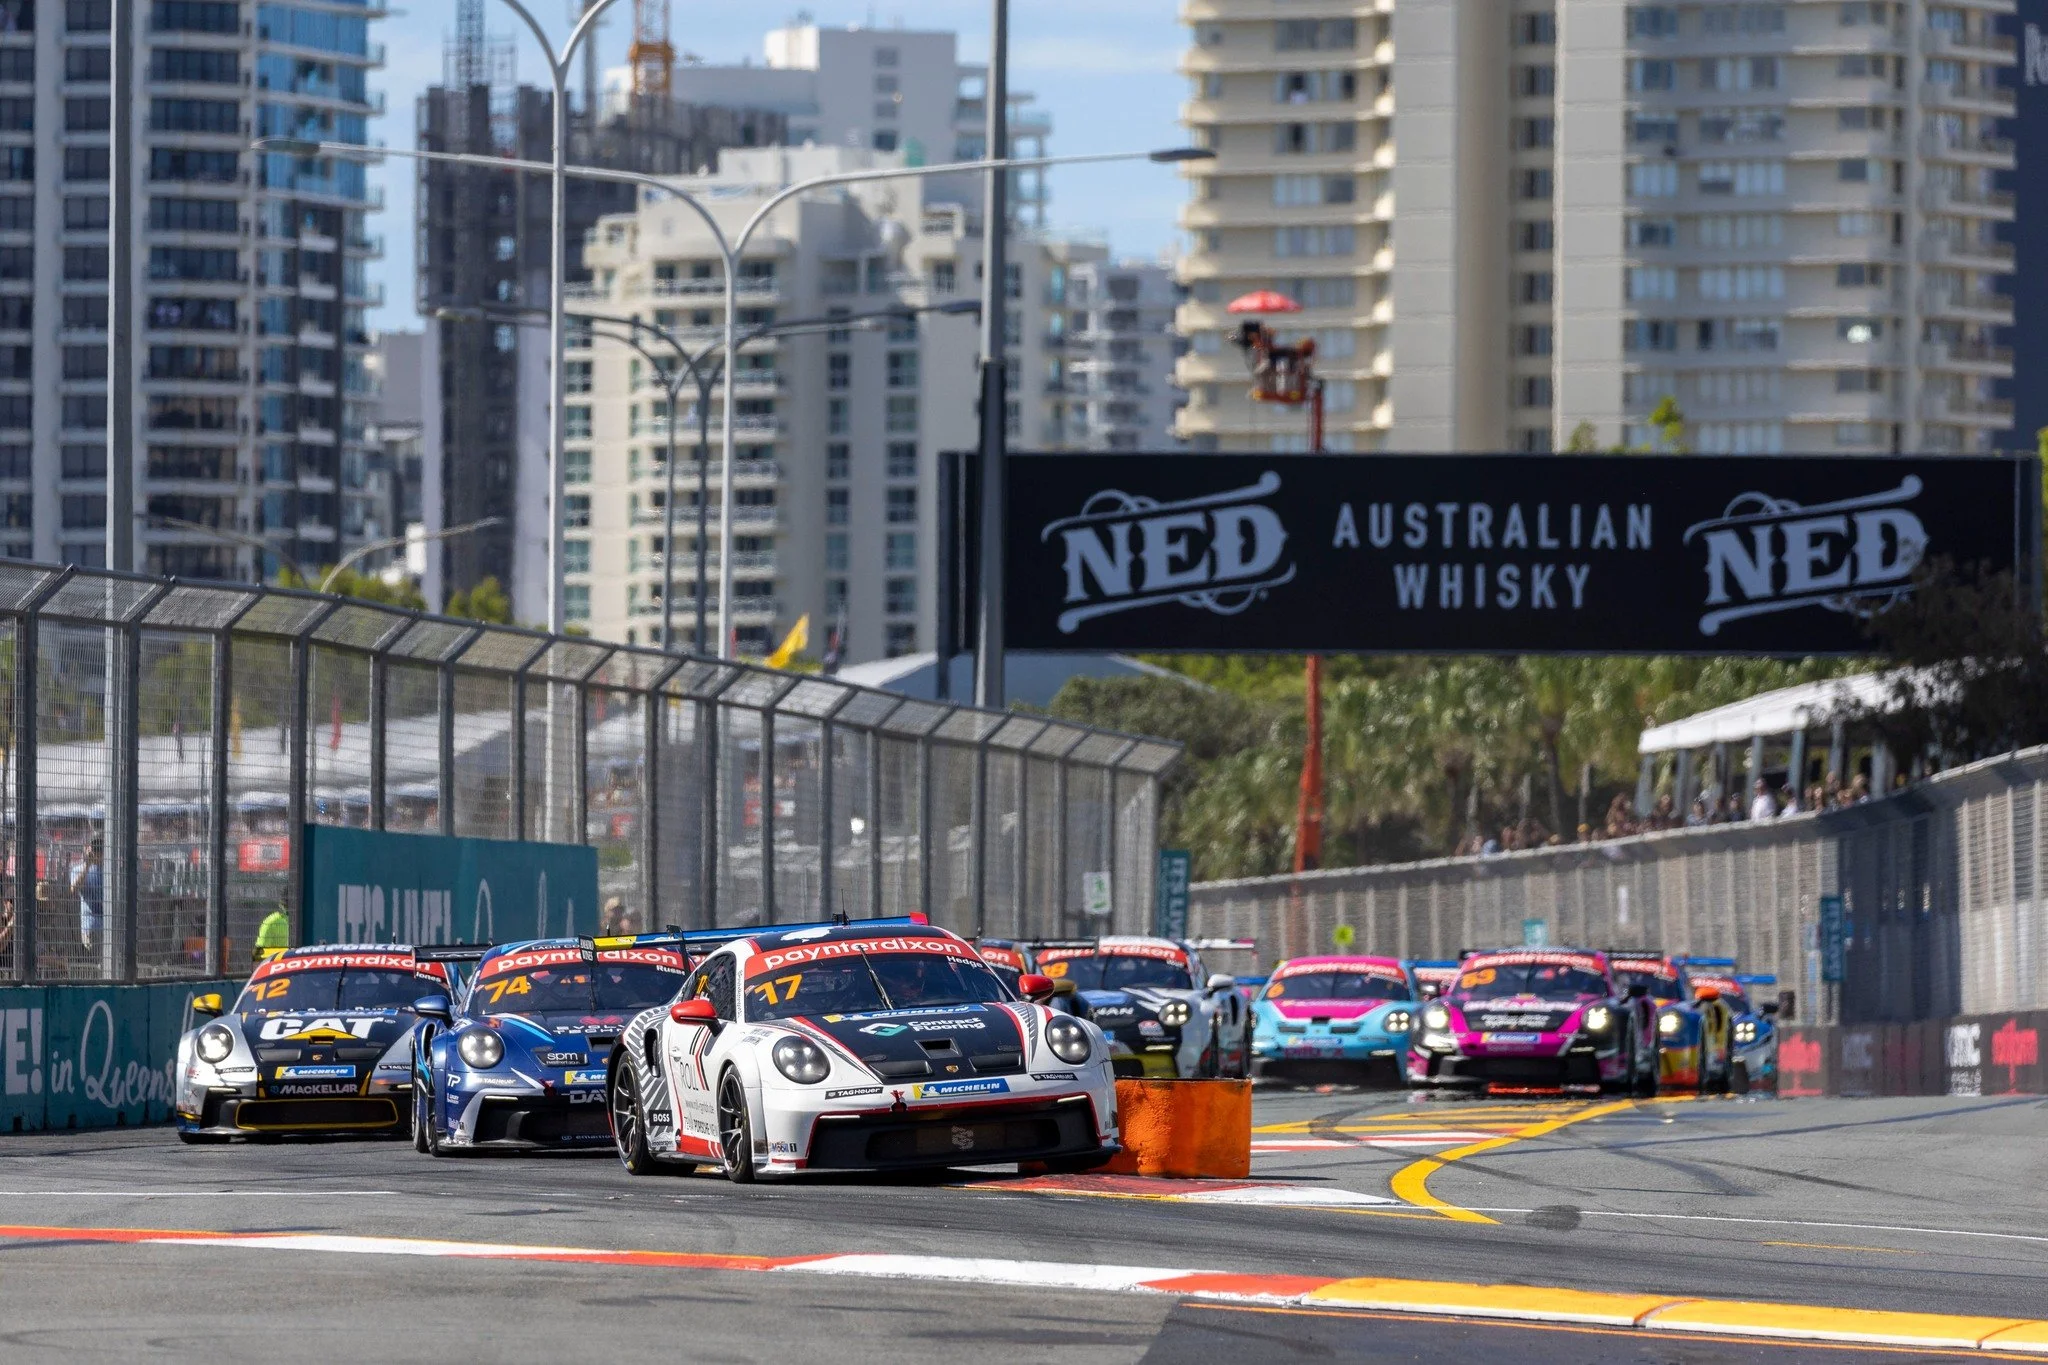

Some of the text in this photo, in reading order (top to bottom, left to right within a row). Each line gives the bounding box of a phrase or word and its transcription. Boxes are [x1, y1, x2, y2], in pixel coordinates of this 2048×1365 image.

[1332, 502, 1655, 550] AUSTRALIAN
[1063, 503, 1289, 600] NED
[1703, 503, 1929, 602] NED
[1393, 562, 1592, 611] WHISKY
[269, 954, 431, 975] paynterdixon
[498, 949, 678, 973] payntrdixon
[763, 937, 961, 970] paynterdixon
[946, 955, 984, 969] Hedge
[250, 978, 291, 1002] 12
[484, 975, 531, 1004] 74
[754, 974, 803, 1006] 17
[260, 1017, 383, 1040] CAT
[908, 1017, 982, 1027] Contract
[913, 1022, 986, 1032] Flooring
[547, 1052, 578, 1064] spm
[52, 1051, 75, 1095] in
[941, 1082, 1000, 1094] MICHELIN
[653, 1113, 670, 1123] BOSS
